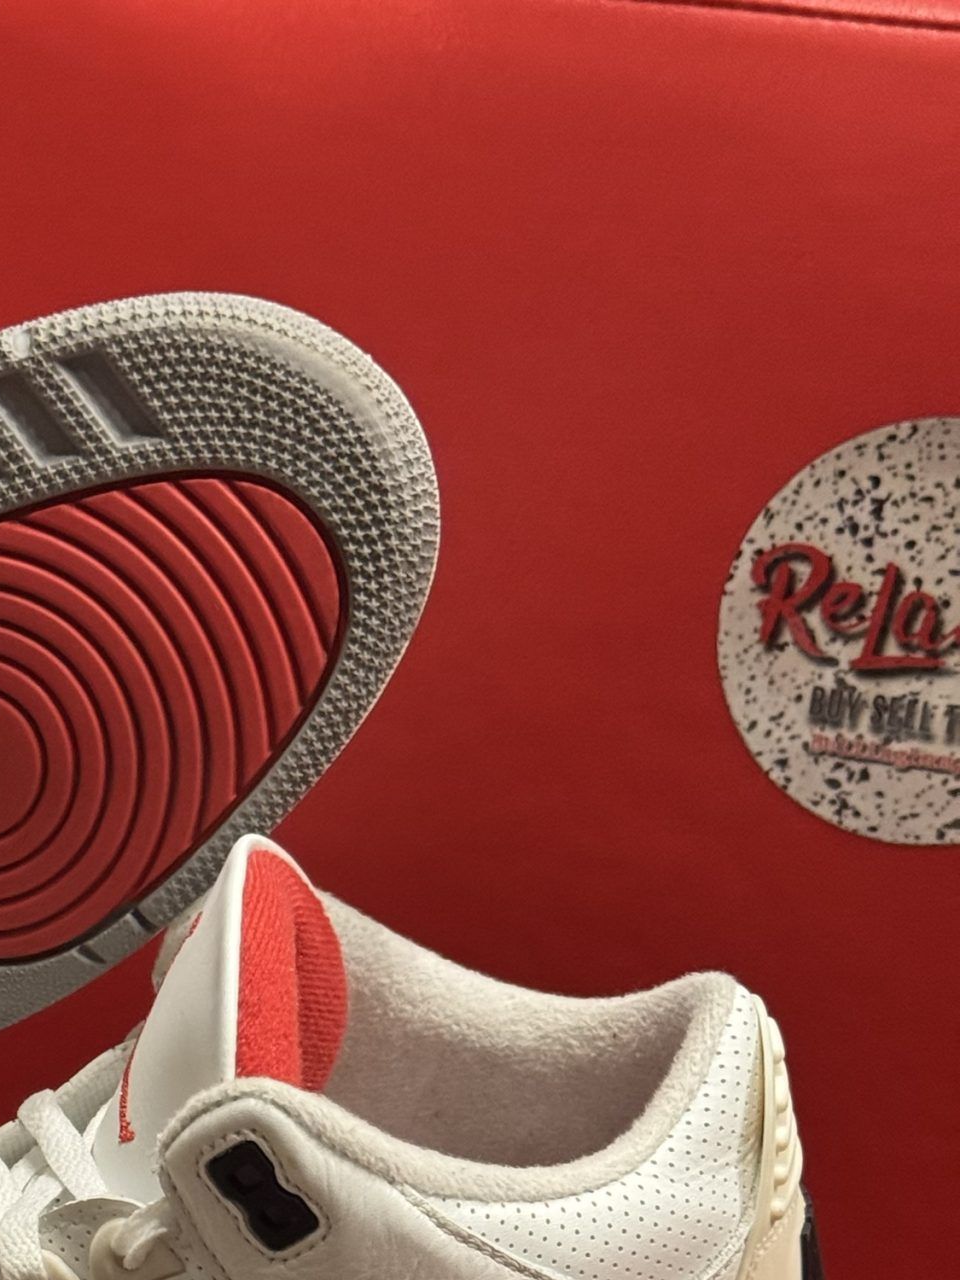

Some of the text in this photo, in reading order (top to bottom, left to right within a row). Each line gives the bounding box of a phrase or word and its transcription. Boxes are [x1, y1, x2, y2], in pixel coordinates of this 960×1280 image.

[751, 543, 960, 671] ReLa
[809, 686, 863, 726] BUY
[871, 694, 933, 738] SELL
